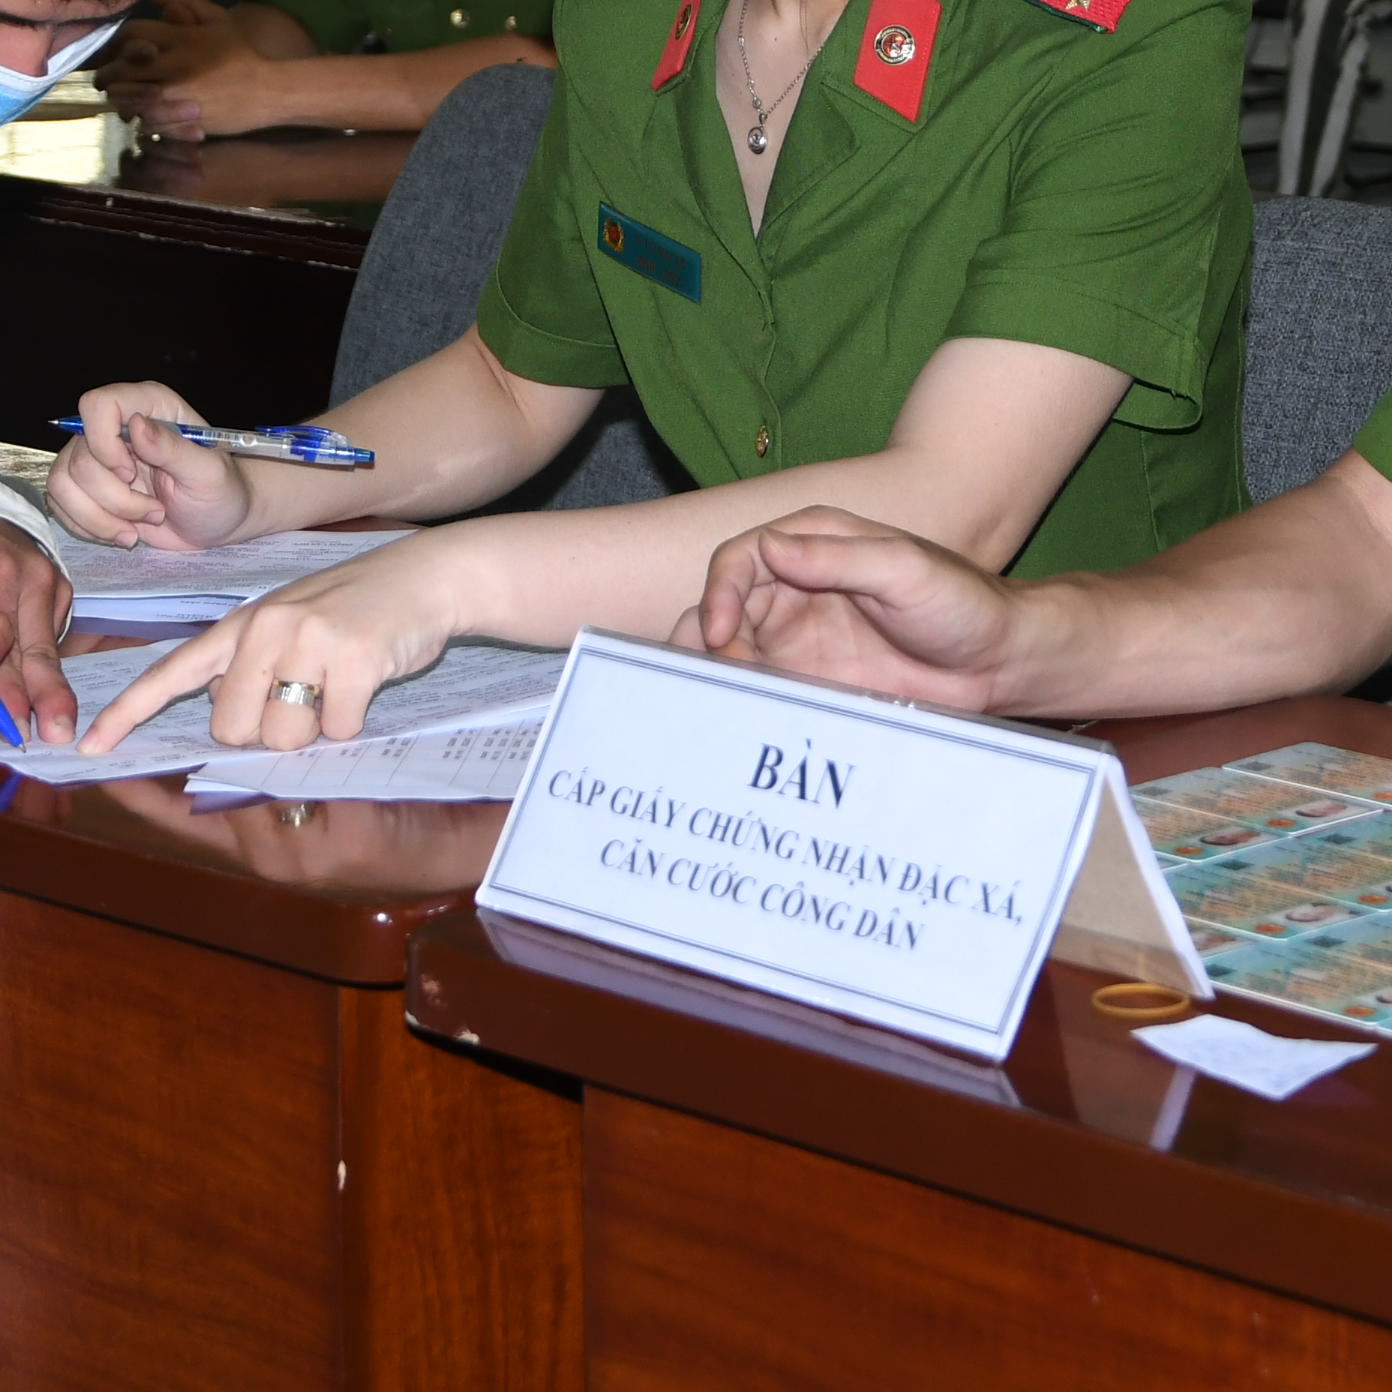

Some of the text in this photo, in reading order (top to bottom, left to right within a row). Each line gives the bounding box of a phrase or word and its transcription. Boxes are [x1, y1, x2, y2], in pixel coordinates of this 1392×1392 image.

[748, 738, 856, 809] BÀN
[547, 766, 606, 808] CẤP
[609, 786, 686, 829] GIẤY
[688, 810, 801, 860] CHỨNG
[800, 837, 897, 888] NHẬN
[898, 862, 970, 906] ĐẶC
[599, 838, 925, 951] CĂN CƯỚC CÔNG DÂN
